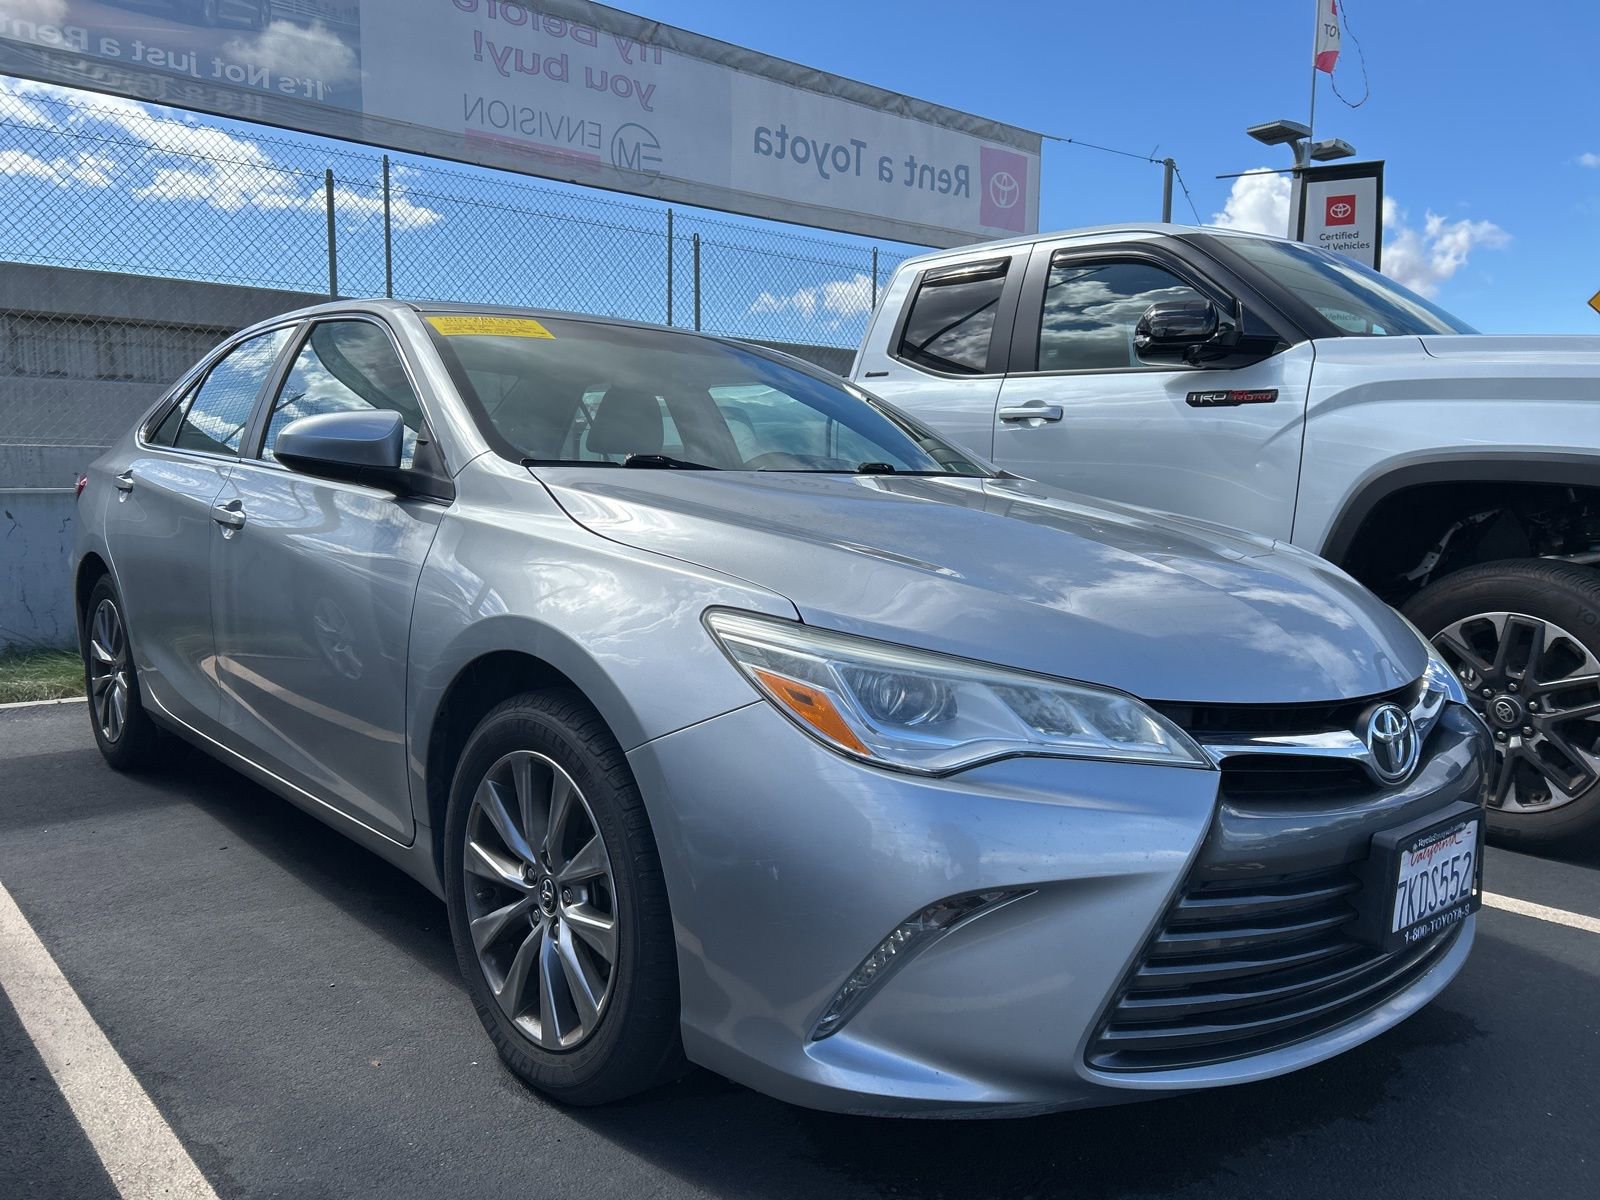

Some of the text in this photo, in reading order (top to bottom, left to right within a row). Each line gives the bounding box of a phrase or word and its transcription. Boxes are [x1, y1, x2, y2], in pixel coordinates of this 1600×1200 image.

[1319, 231, 1360, 241] Certified
[1332, 240, 1370, 250] Vehicles
[1398, 851, 1472, 930] 7KDS552
